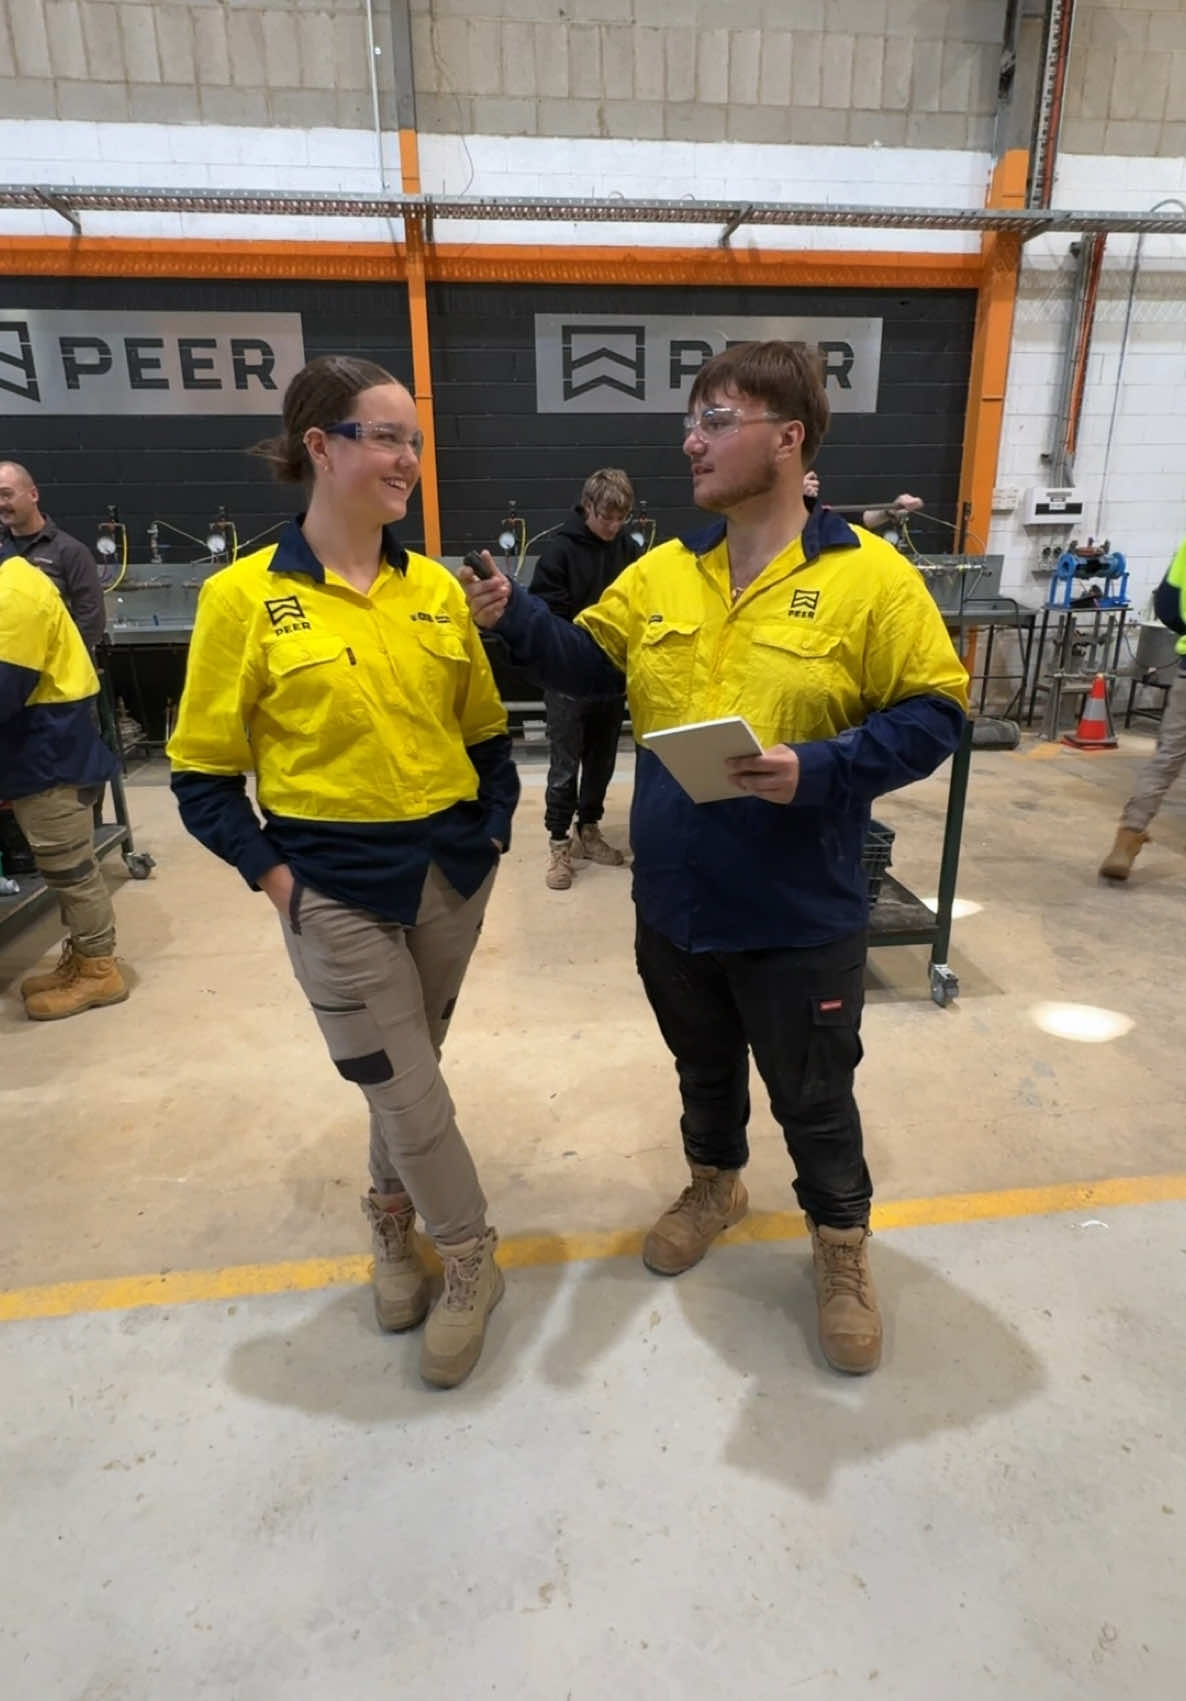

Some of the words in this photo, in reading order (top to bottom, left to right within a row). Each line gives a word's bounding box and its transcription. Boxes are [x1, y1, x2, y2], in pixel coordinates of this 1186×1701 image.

[59, 337, 278, 390] PEER
[670, 340, 855, 389] PR
[274, 621, 311, 637] PEER
